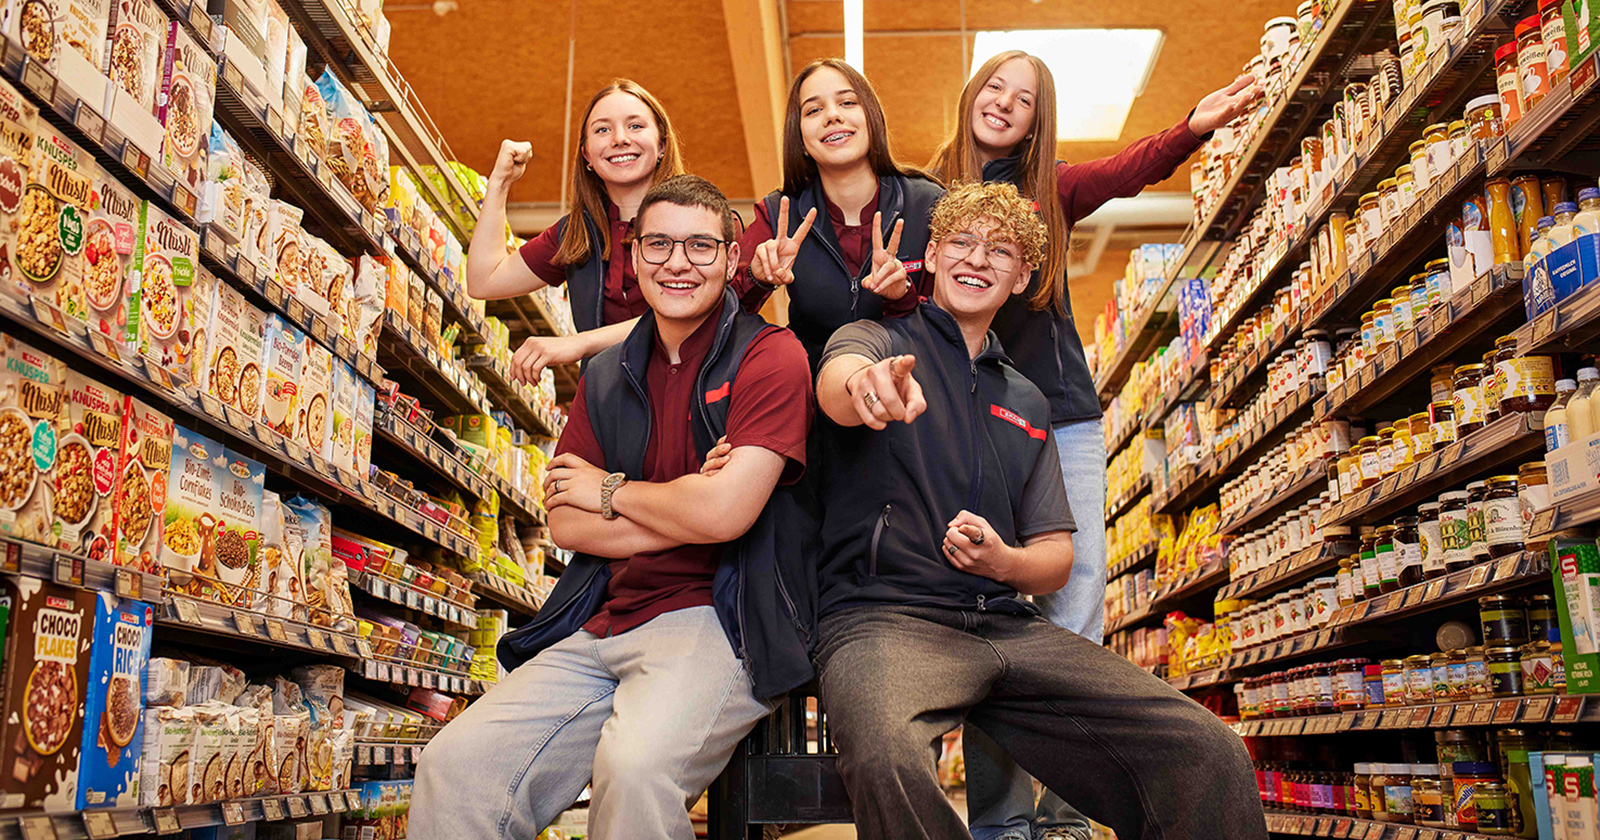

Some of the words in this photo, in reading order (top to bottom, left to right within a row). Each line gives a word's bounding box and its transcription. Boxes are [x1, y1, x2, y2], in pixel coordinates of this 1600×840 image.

[183, 44, 212, 86] Müsli
[37, 136, 77, 172] KNUSPER
[51, 164, 89, 203] Müsli
[101, 184, 134, 222] Müsli
[157, 221, 191, 256] Müsli
[6, 357, 49, 384] KNUSPER
[22, 382, 61, 416] Müsli
[72, 389, 110, 413] KNUSPER
[85, 412, 120, 443] Müsli
[135, 416, 164, 438] KNUSPER
[145, 438, 171, 465] Müsli
[180, 475, 212, 500] Cornflakes
[220, 492, 255, 517] Schoko-Reis
[40, 613, 78, 639] CHOCO
[117, 626, 141, 647] CHOCO
[37, 636, 76, 659] FLAKES
[115, 647, 139, 675] RICE
